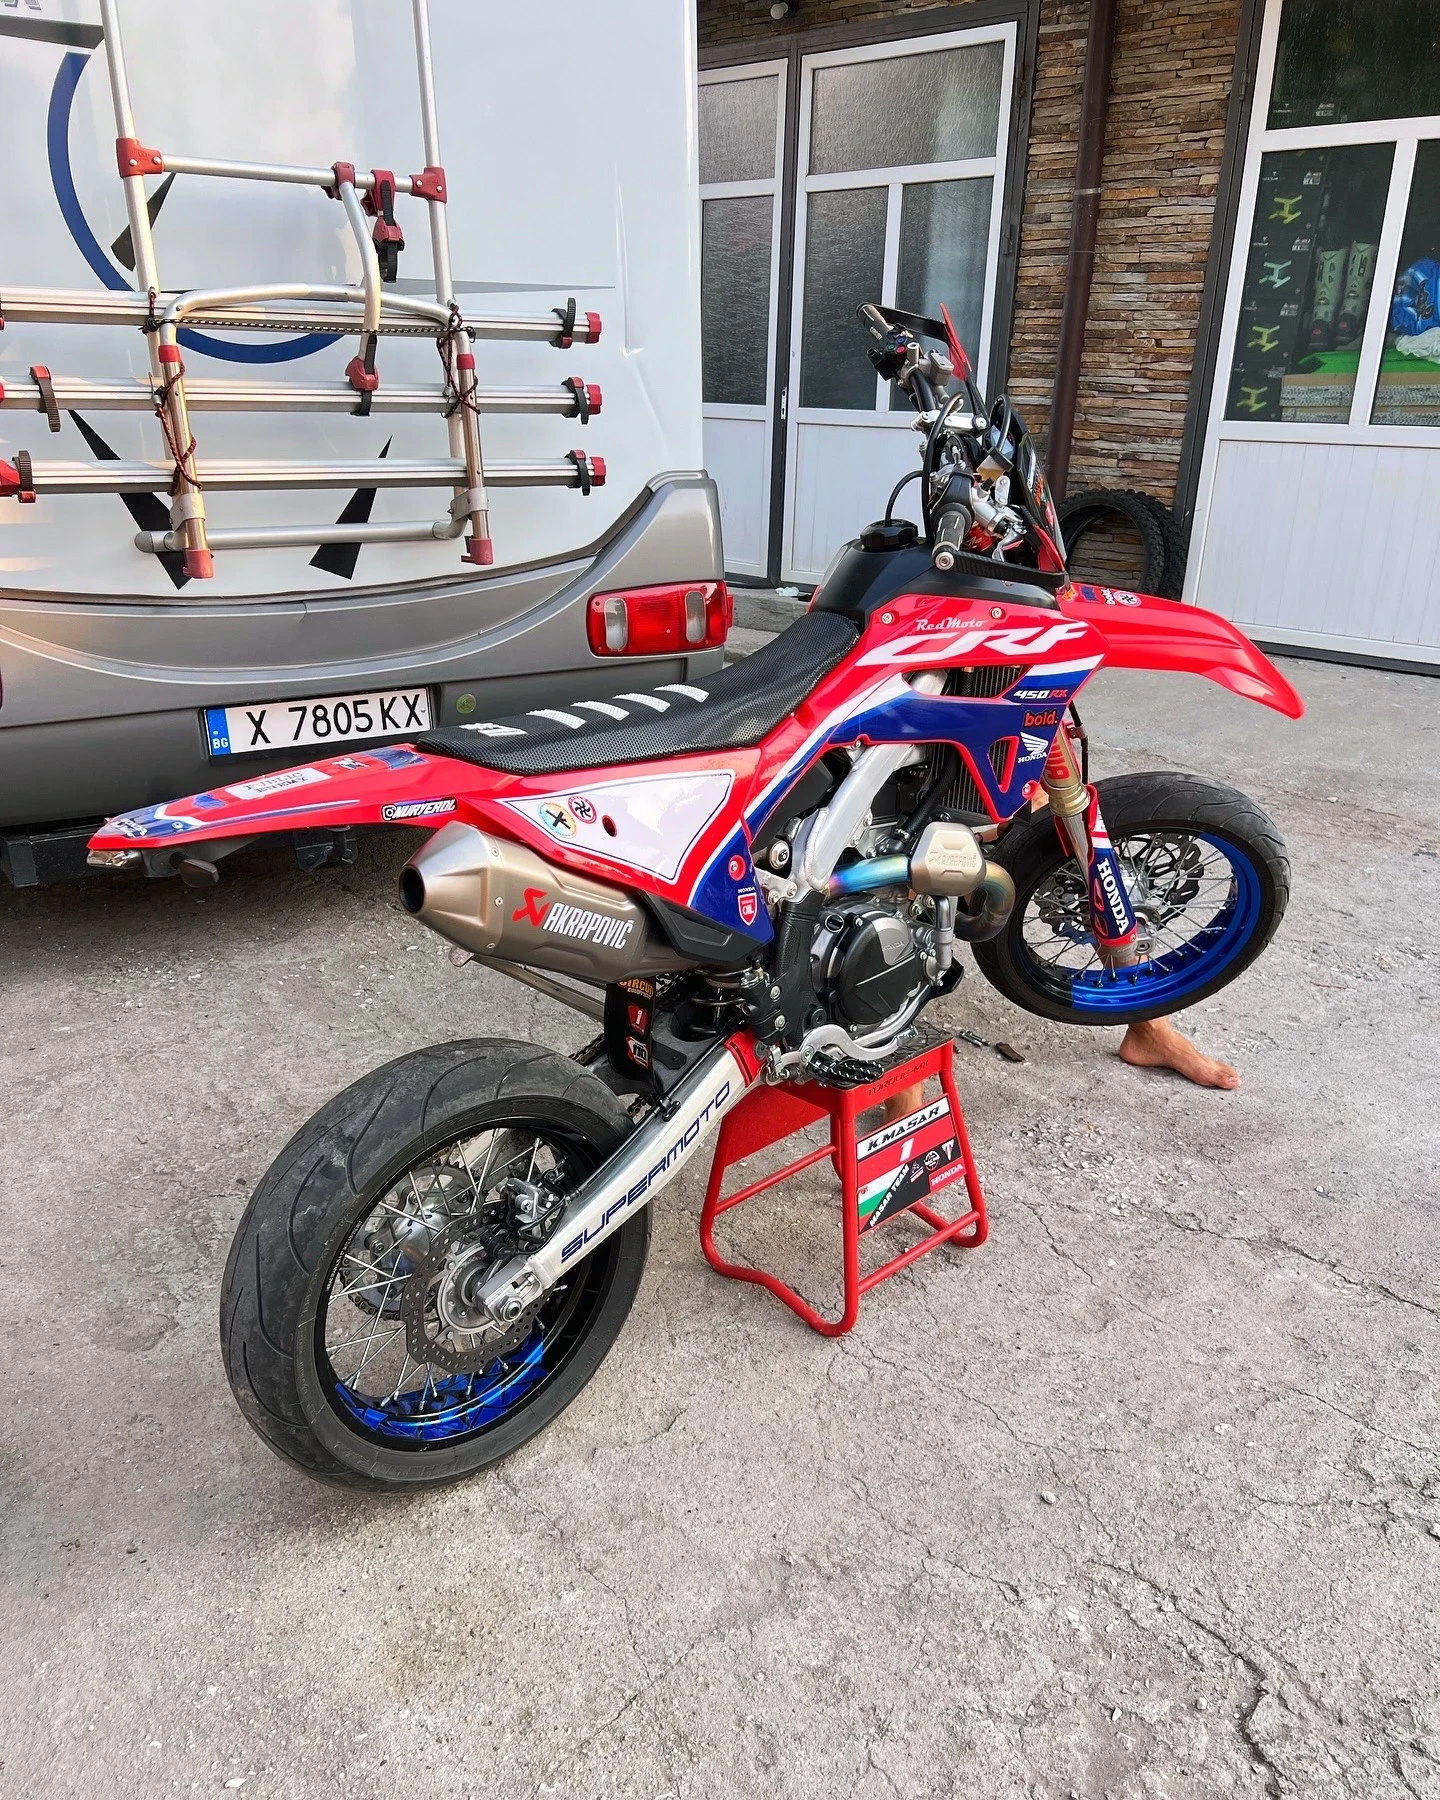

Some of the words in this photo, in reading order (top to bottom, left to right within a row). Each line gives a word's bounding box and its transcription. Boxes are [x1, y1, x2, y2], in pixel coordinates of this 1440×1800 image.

[916, 617, 988, 632] RedMoto
[854, 621, 1089, 667] CRF
[246, 709, 271, 746] X
[288, 699, 373, 741] 7805
[379, 694, 424, 731] KX
[212, 738, 229, 749] BG
[1018, 752, 1048, 763] HONDA
[742, 903, 754, 915] OIL
[1097, 858, 1129, 935] HONDA
[899, 1137, 914, 1163] 1
[561, 1080, 730, 1264] SUPERMOTO
[931, 1163, 964, 1186] HONDA
[869, 1193, 893, 1228] MASAR
[891, 1164, 910, 1193] TEAM
